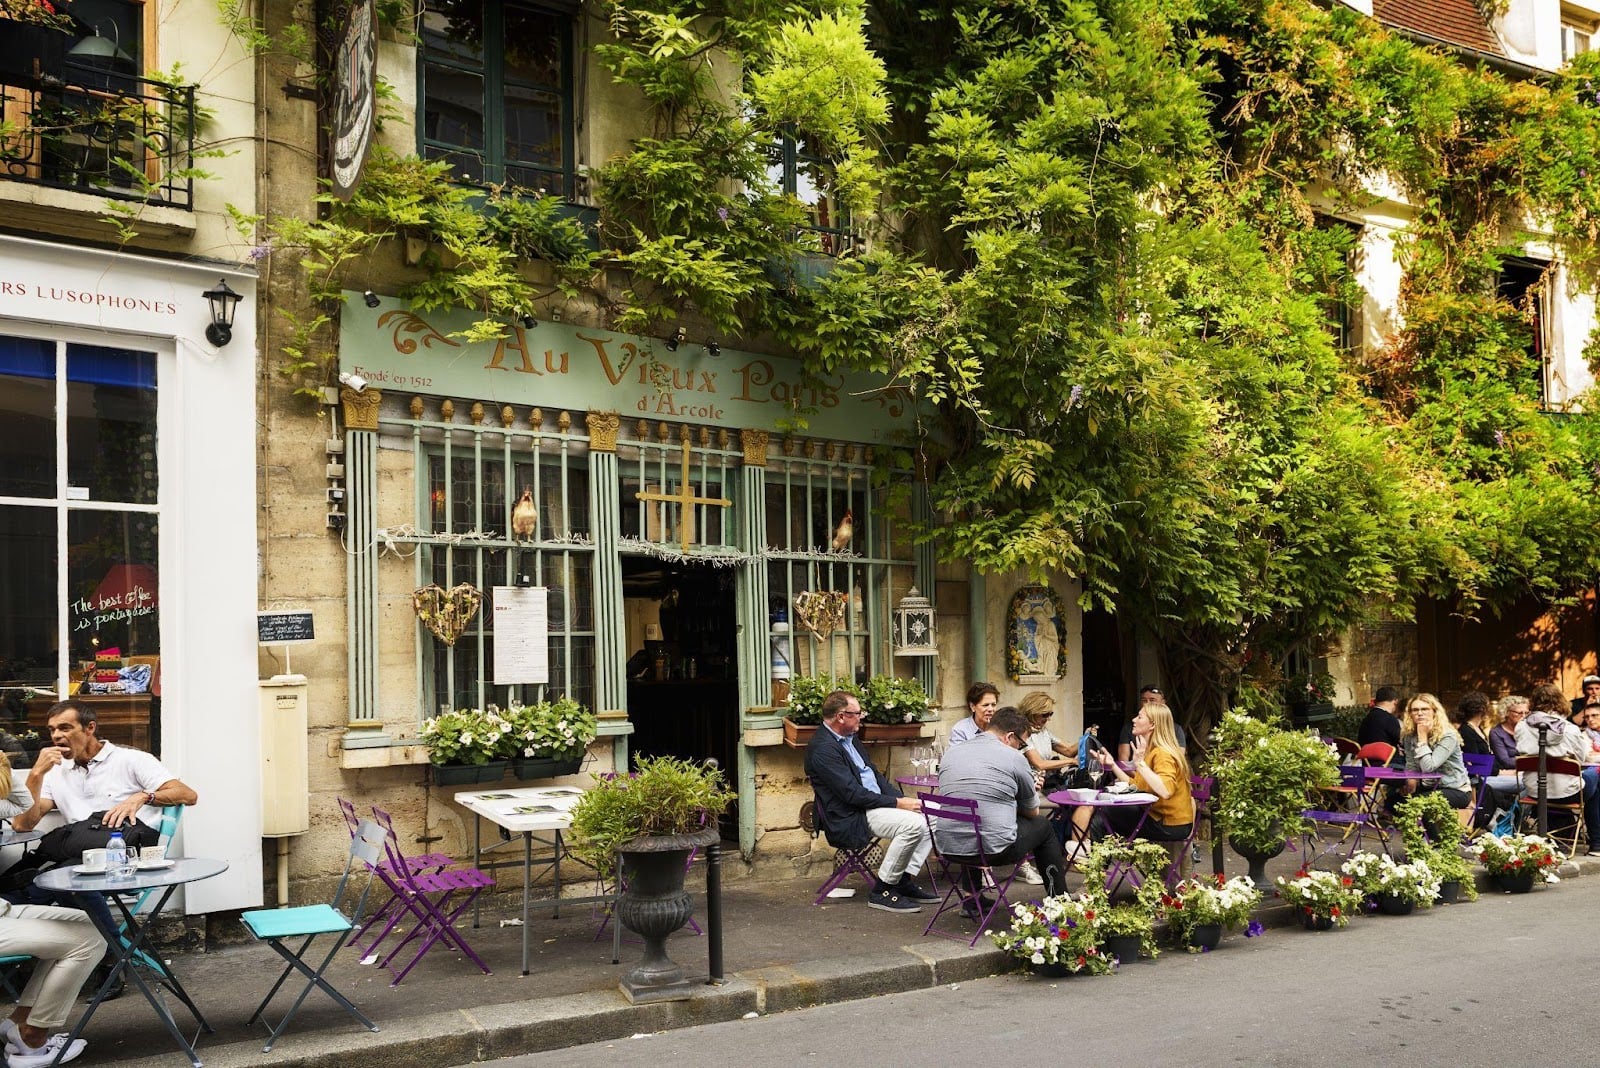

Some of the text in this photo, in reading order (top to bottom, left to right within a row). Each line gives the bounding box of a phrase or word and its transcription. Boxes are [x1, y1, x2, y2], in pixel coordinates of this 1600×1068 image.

[37, 285, 177, 315] LUSOPHONES
[351, 365, 433, 389] Fondé en 1512
[484, 325, 845, 409] Au Vieux Paris
[637, 391, 725, 420] d'Arcole
[70, 597, 96, 615] The
[99, 593, 122, 611] best
[74, 617, 92, 632] is
